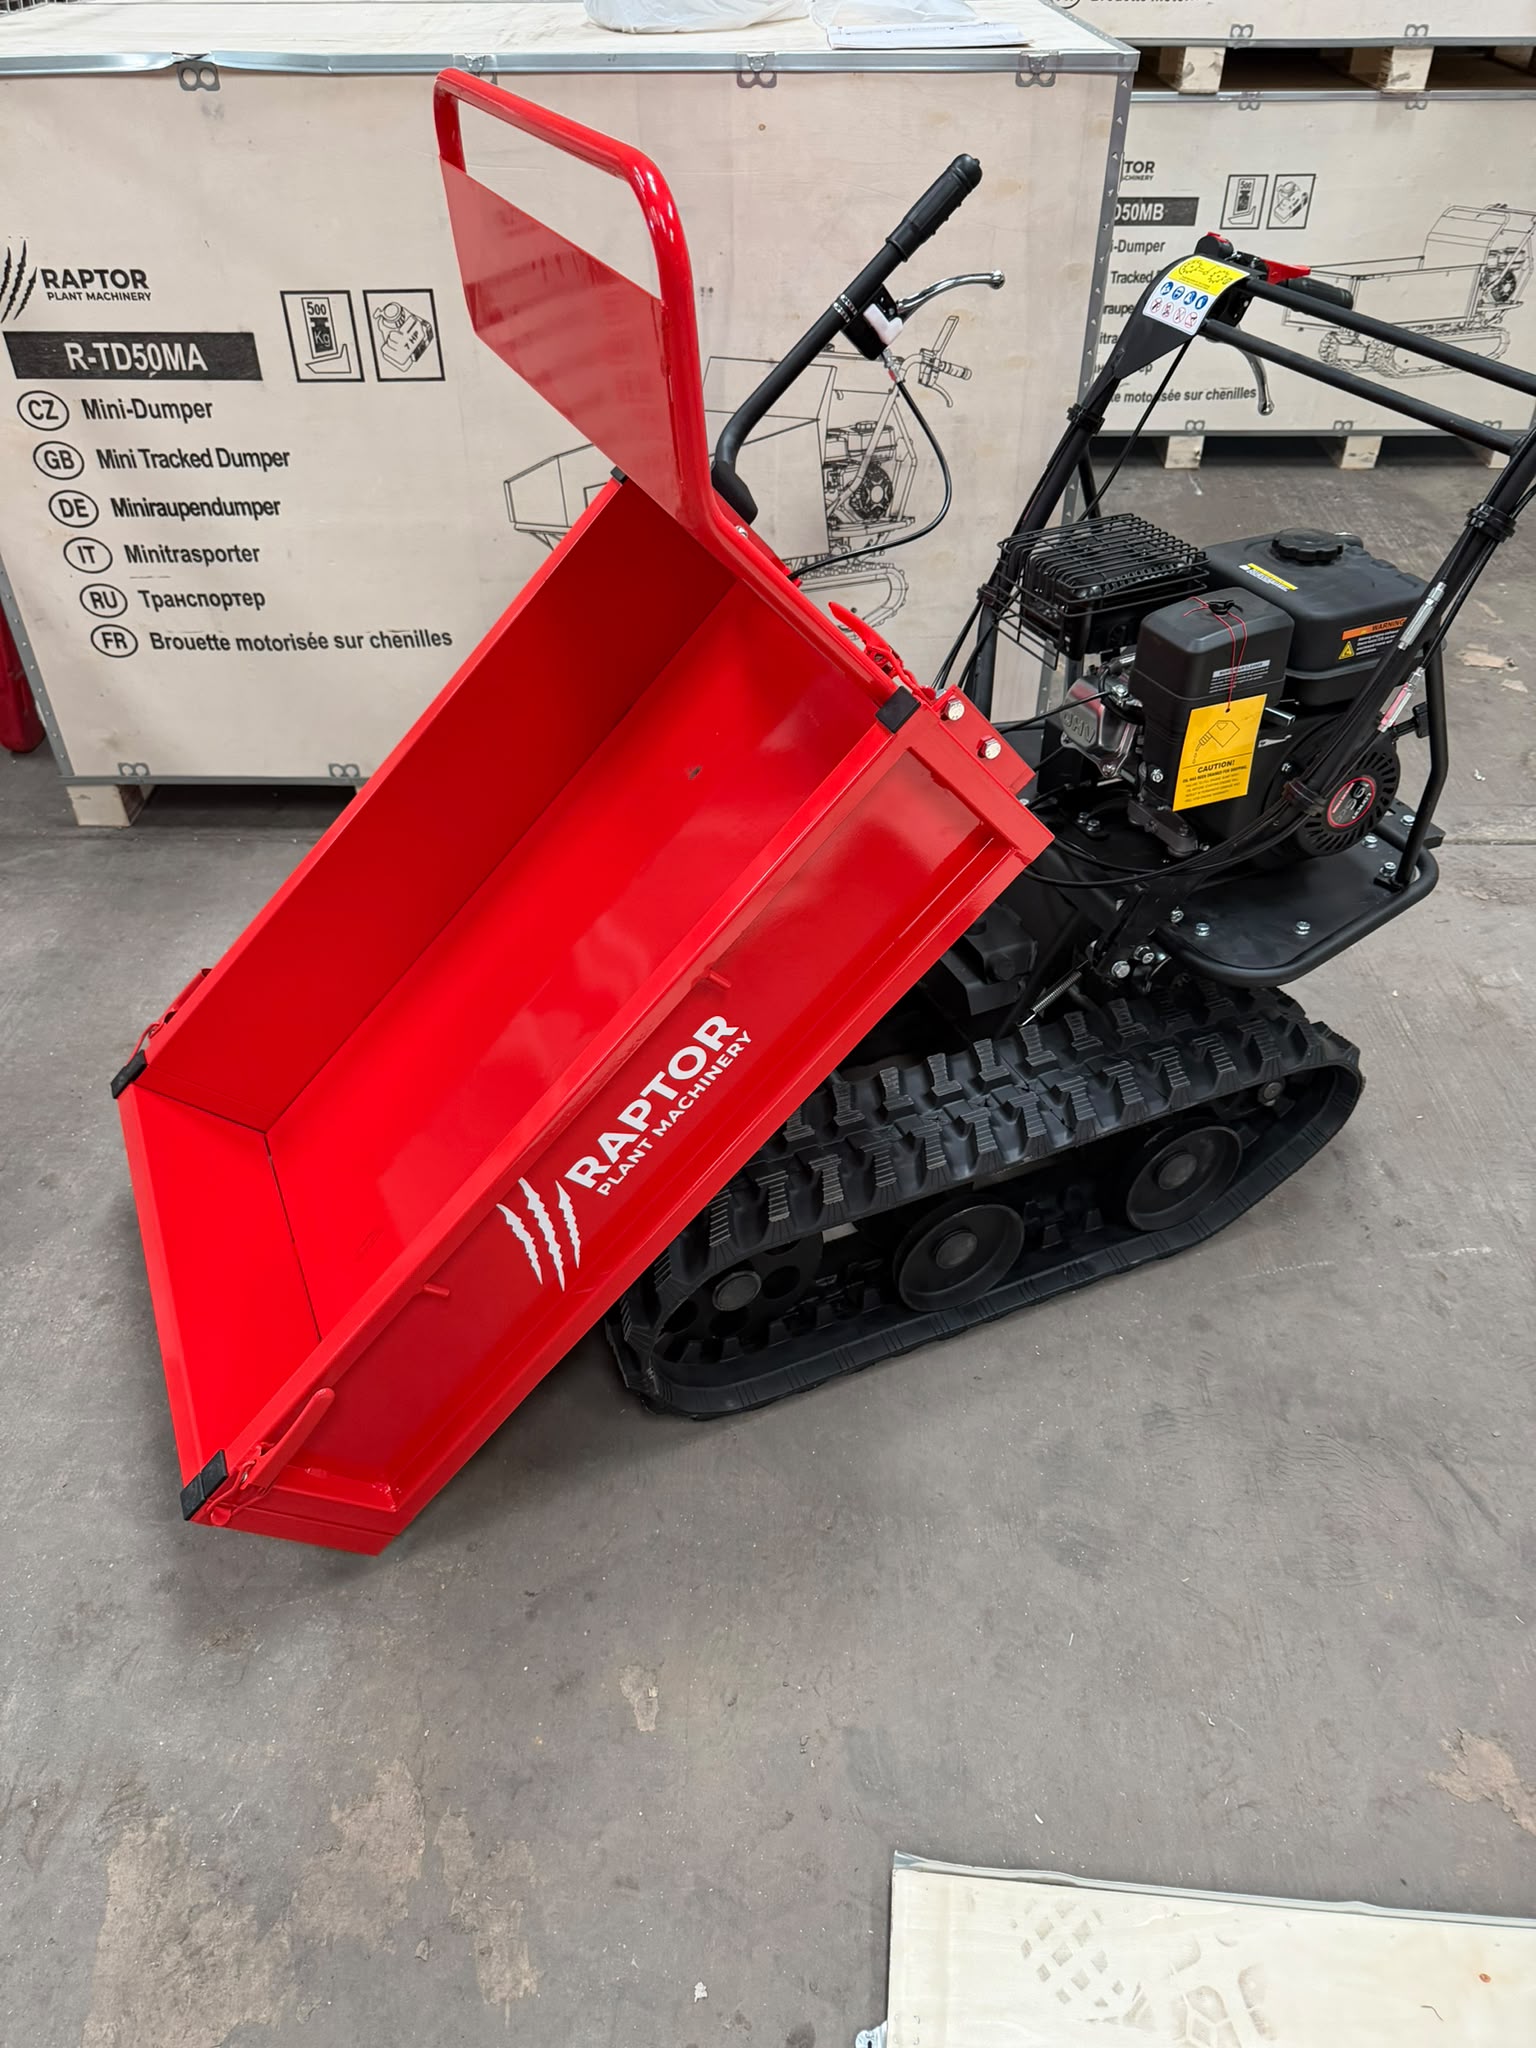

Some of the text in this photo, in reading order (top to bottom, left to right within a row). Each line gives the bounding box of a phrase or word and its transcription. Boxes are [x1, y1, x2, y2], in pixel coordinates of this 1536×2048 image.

[1124, 161, 1155, 174] TOR
[41, 268, 149, 290] RAPTOR
[47, 291, 151, 302] PLANT MACHINERY
[306, 302, 327, 316] 500
[314, 332, 331, 347] Kg
[64, 342, 208, 372] R-TD50MA
[1184, 390, 1204, 401] sur
[1205, 386, 1257, 401] chenilles
[29, 400, 59, 421] CZ
[81, 398, 213, 424] Mini-Dumper
[44, 450, 74, 470] GB
[96, 448, 290, 472] Mini Tracked Dumper
[59, 499, 88, 519] DE
[110, 497, 281, 521] Miniraupendumper
[77, 546, 97, 564] IT
[124, 544, 260, 567] Minitrasporter
[90, 591, 118, 609] RU
[138, 590, 266, 613] Транспортер
[101, 631, 128, 650] FR
[149, 629, 452, 651] Brouette motorisée sur chenilles
[1197, 760, 1235, 774] CAUTION!
[564, 1015, 739, 1189] RAPTOR
[596, 1030, 752, 1197] PLANT MACHINERY
